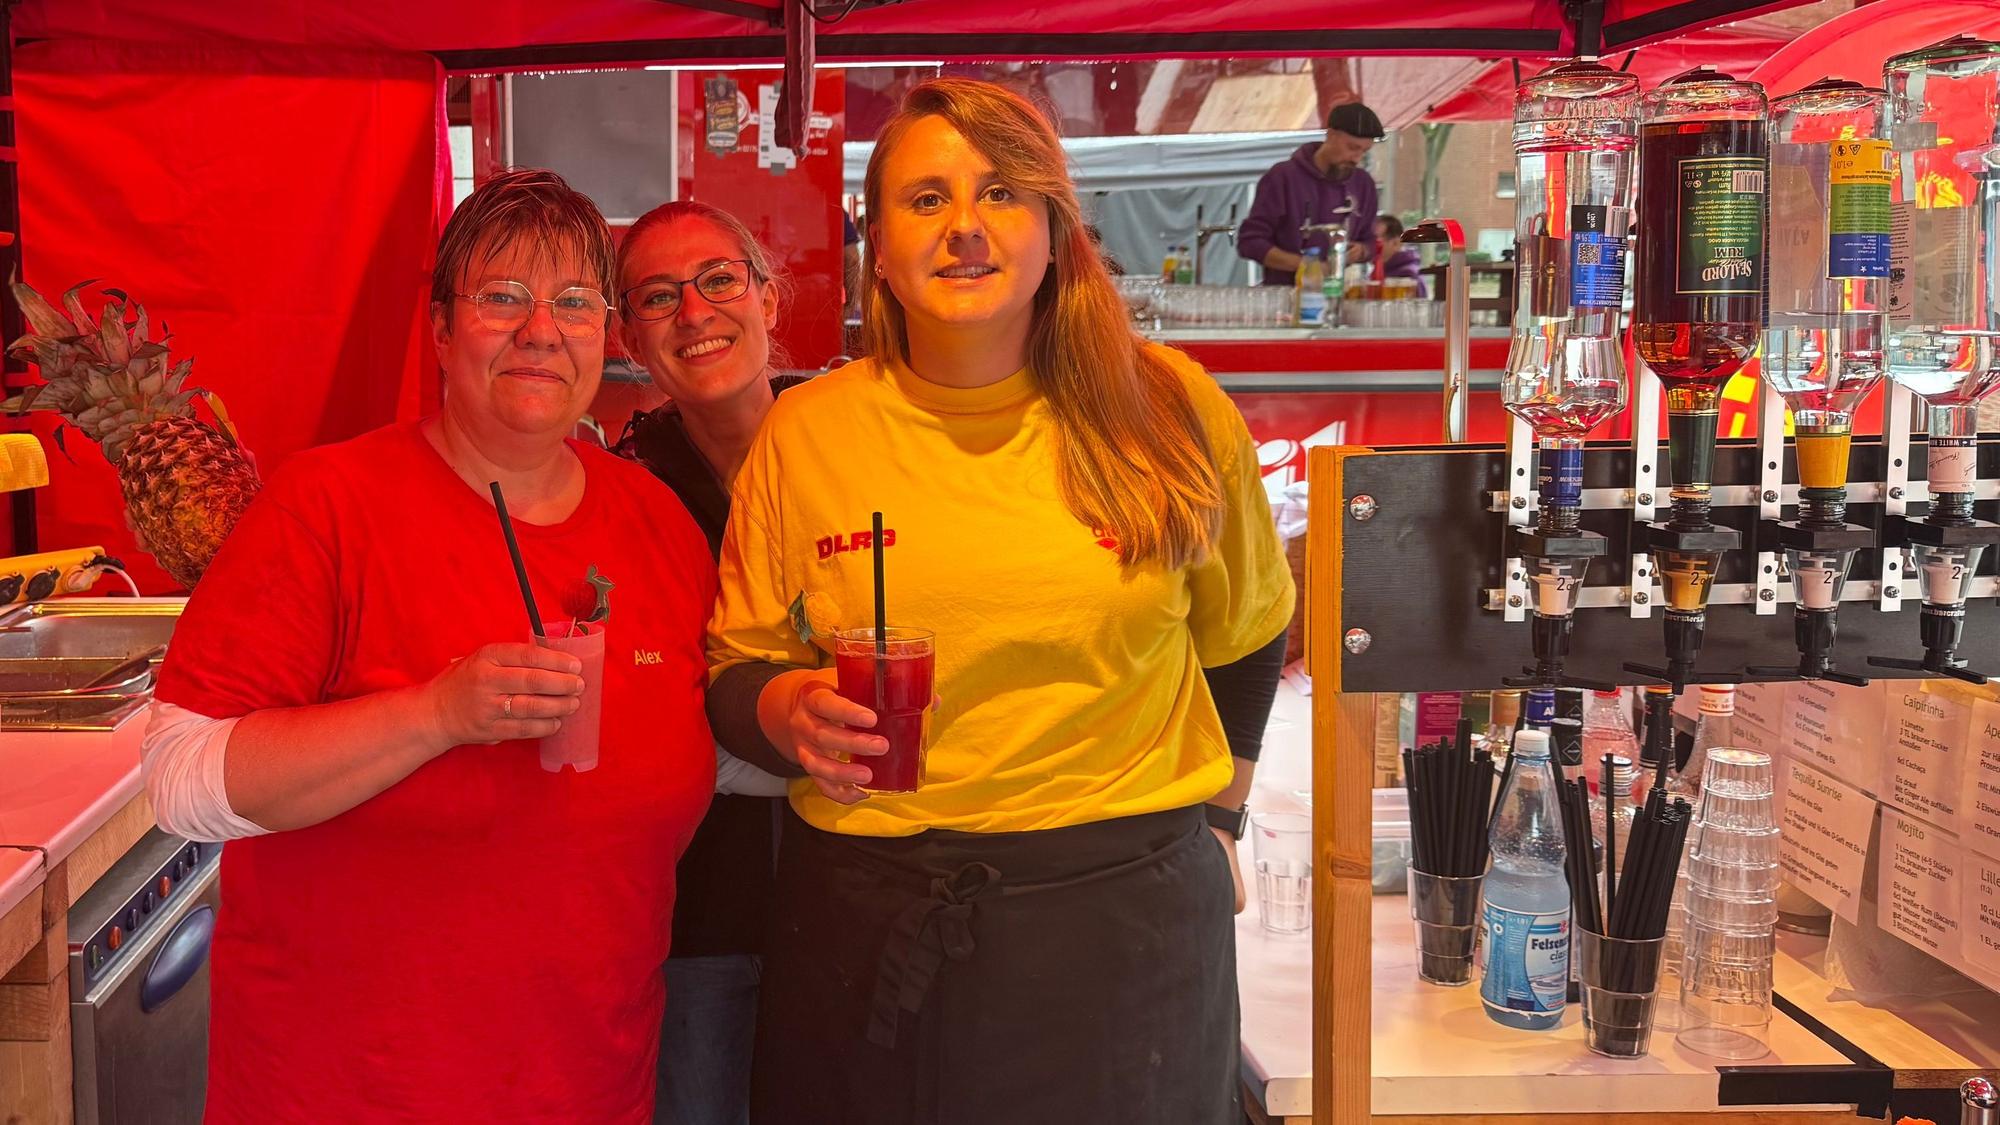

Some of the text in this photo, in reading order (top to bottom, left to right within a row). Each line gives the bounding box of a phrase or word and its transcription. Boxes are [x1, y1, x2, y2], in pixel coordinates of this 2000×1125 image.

[1714, 246, 1744, 258] RUM
[816, 528, 896, 560] DLRG
[1824, 570, 1832, 584] 2
[1952, 566, 1961, 579] 2
[634, 648, 664, 666] Alex
[1904, 694, 1944, 719] Caipirinha
[1792, 766, 1842, 801] Tequila Sunrise
[1897, 819, 1925, 840] Mojito
